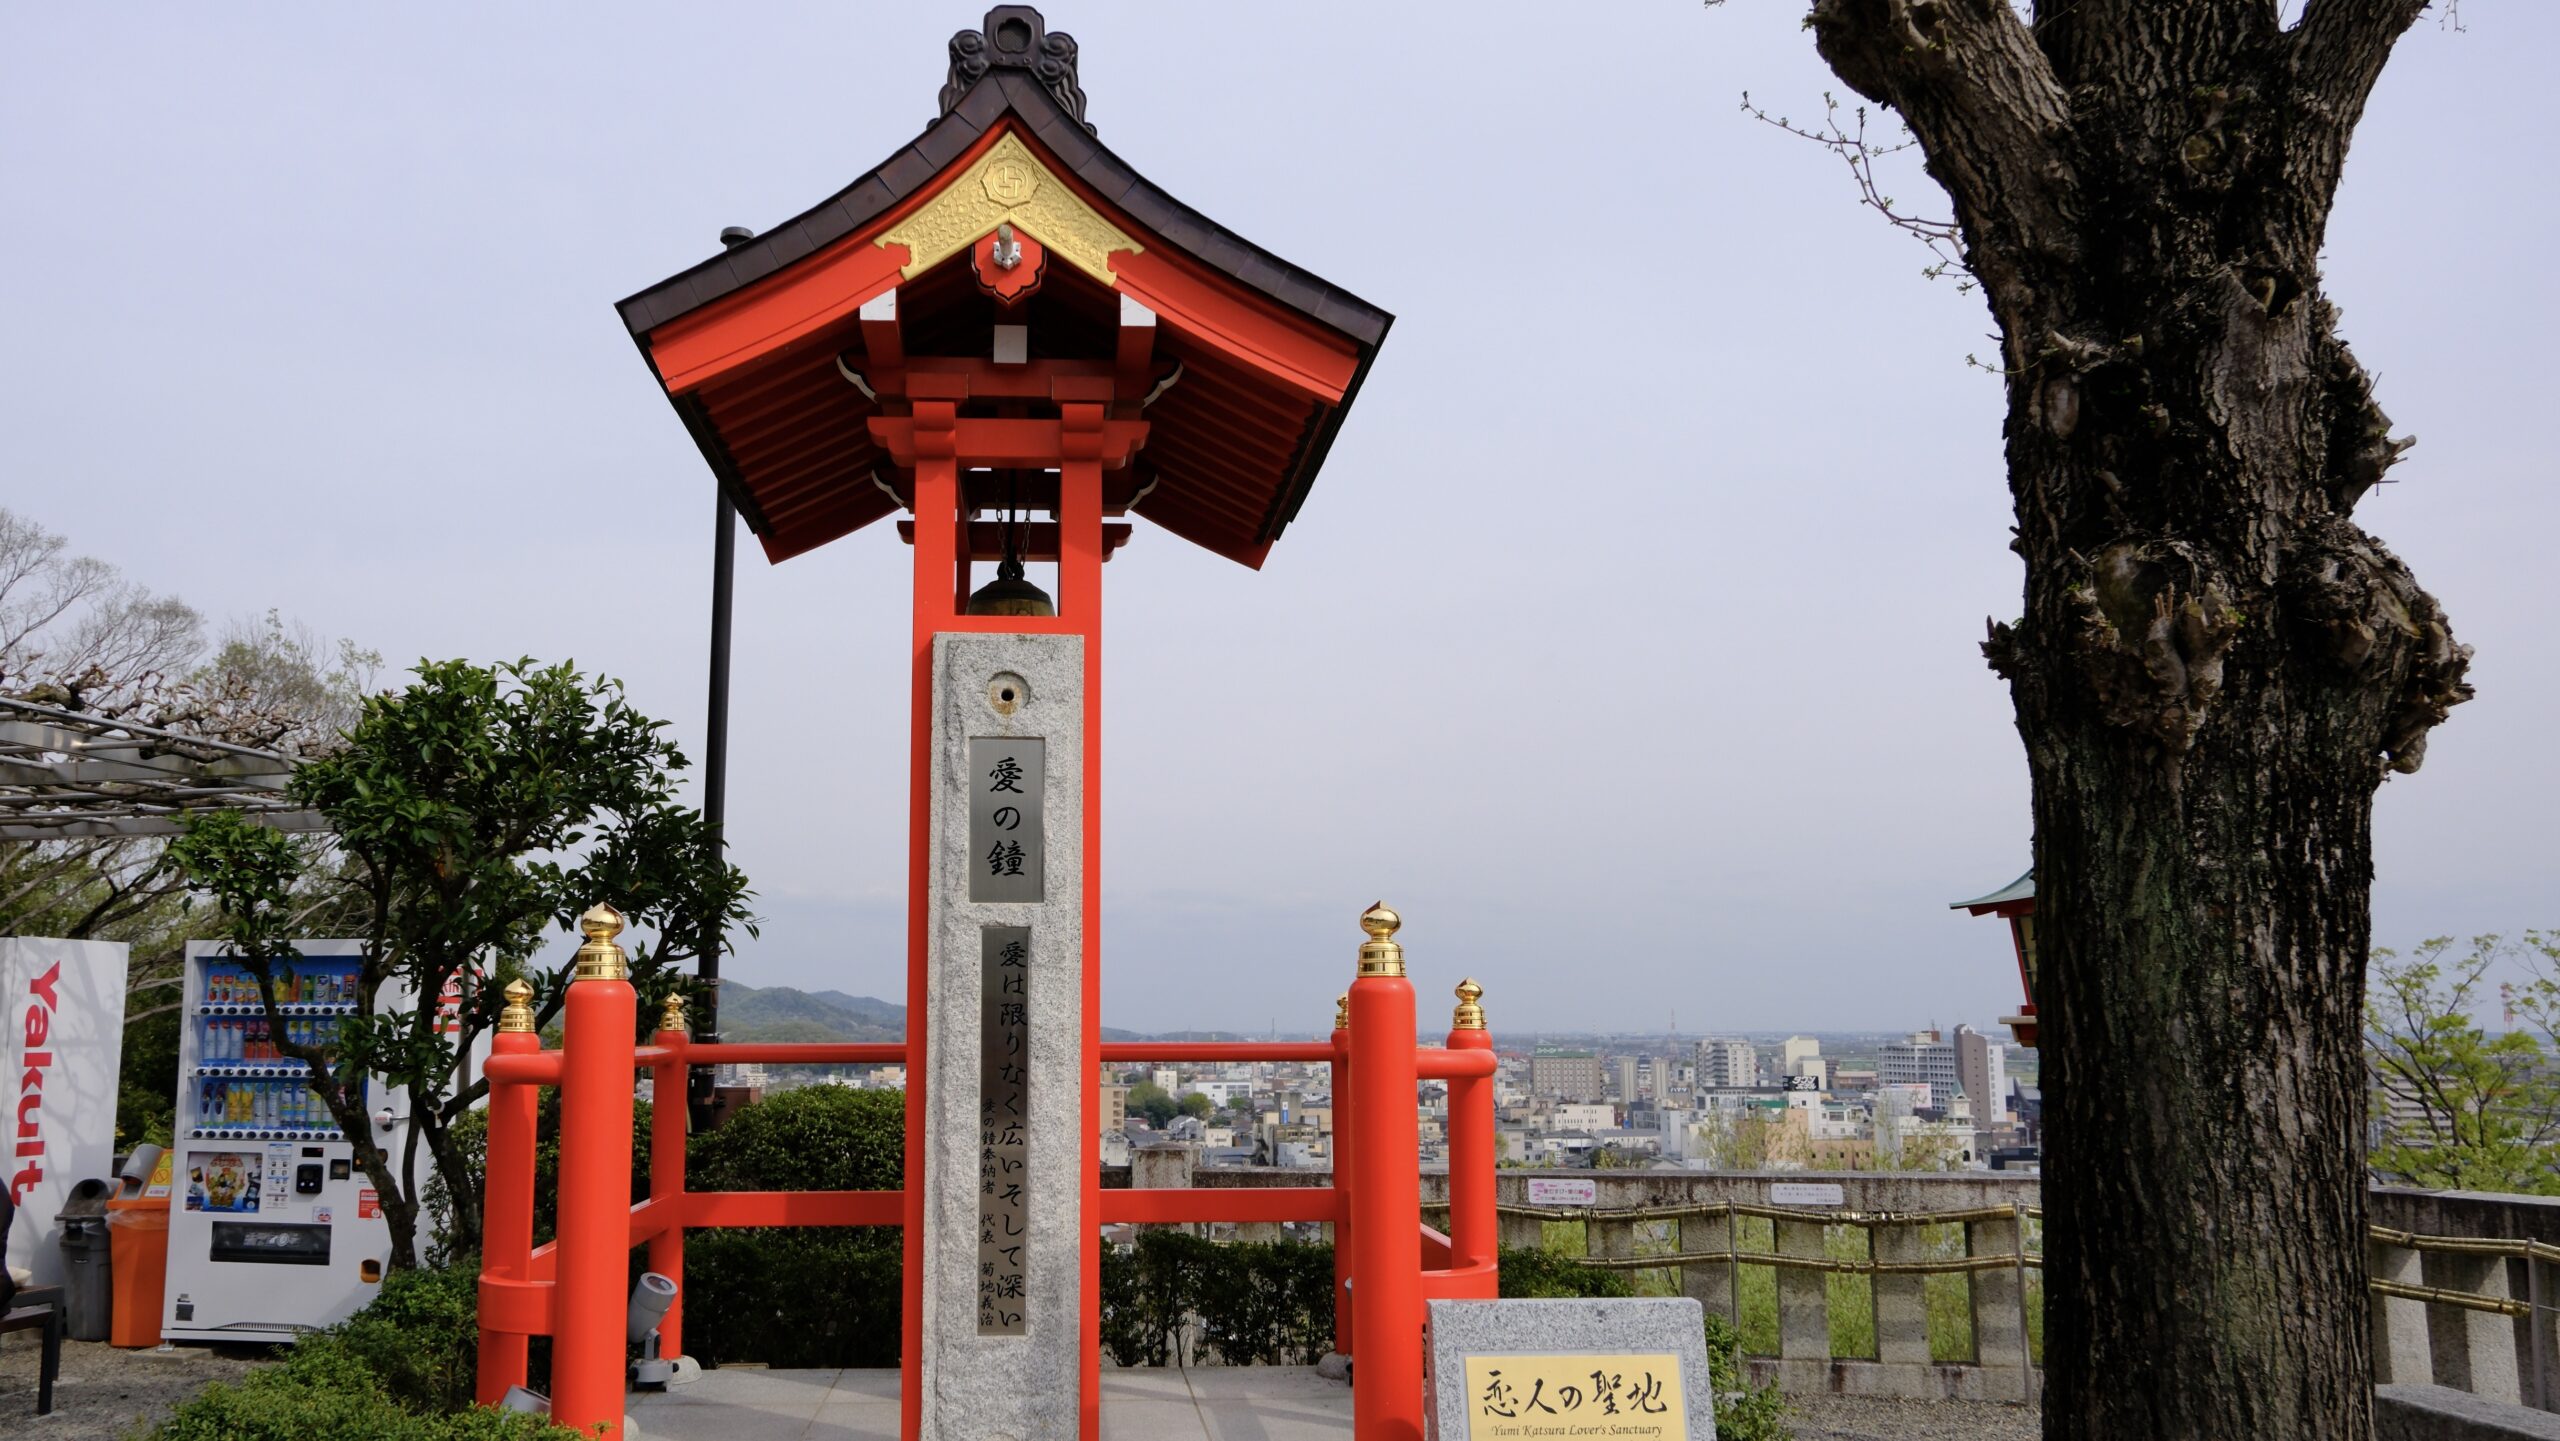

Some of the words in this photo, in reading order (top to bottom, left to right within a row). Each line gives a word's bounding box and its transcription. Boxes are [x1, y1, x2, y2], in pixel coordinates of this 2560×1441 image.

[986, 757, 1026, 876] 愛の鐘
[10, 960, 61, 1207] Yakult
[995, 942, 1028, 1326] 愛は限りなく広いそして深い
[981, 1213, 995, 1243] 代表
[1483, 1370, 1668, 1418] 恋人の聖地
[1491, 1425, 1520, 1437] Yumi
[1522, 1425, 1566, 1438] Katsura
[1569, 1424, 1606, 1437] Lover's
[1608, 1424, 1663, 1438] Sanctuary
